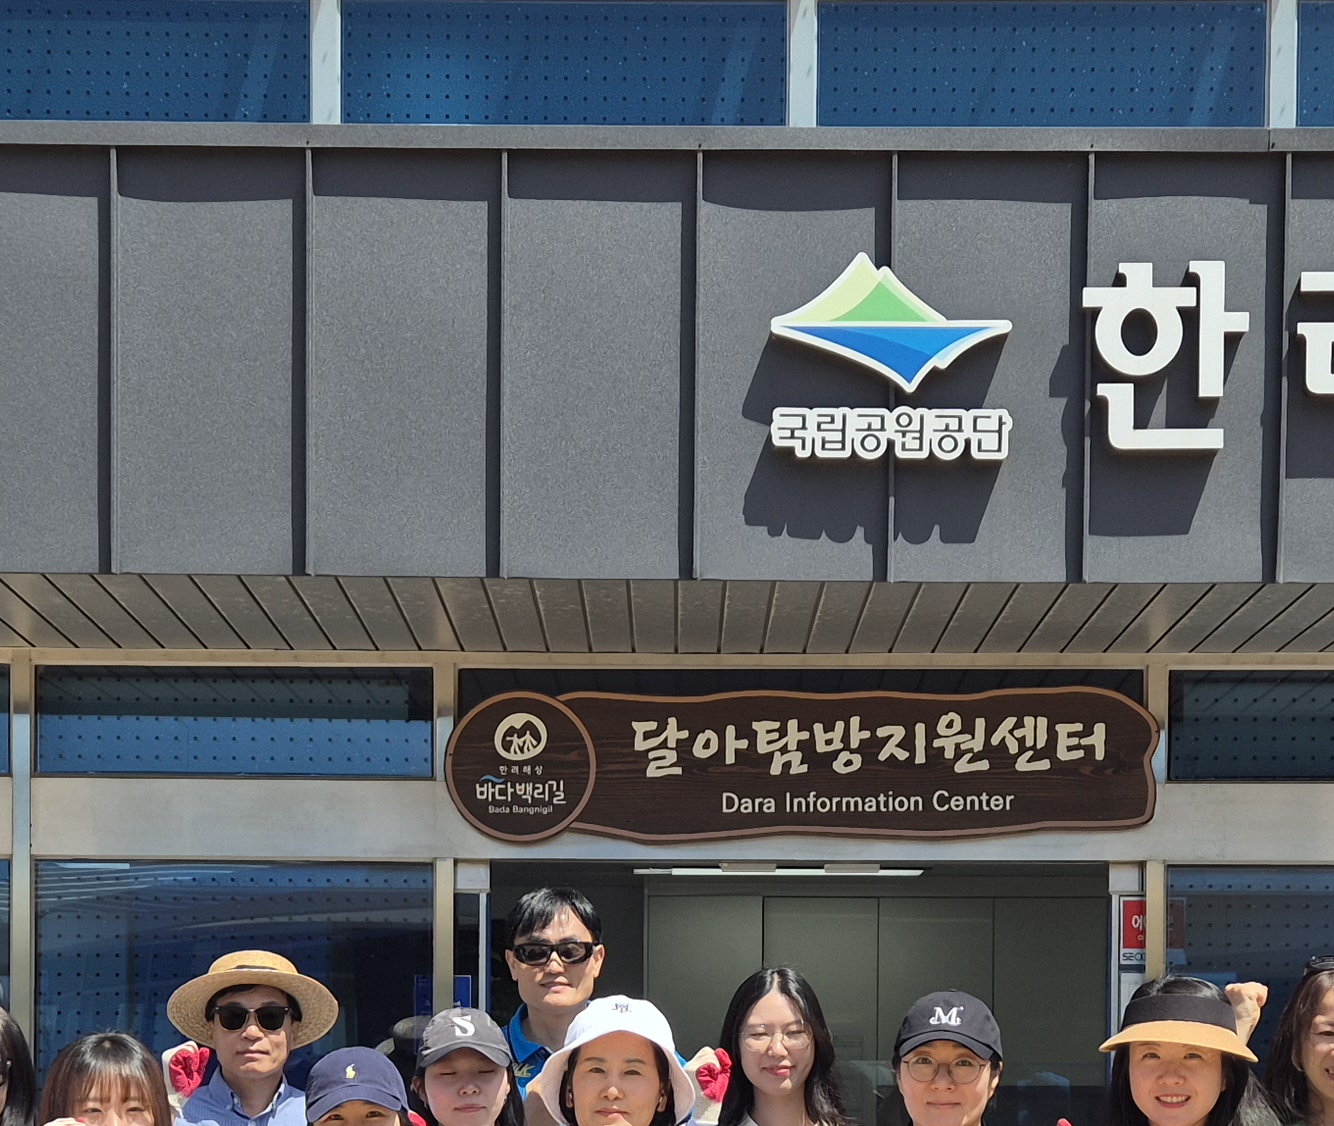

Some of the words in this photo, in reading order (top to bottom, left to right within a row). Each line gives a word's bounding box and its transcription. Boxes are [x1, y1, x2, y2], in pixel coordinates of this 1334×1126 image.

[775, 410, 1010, 456] 국립공원공단
[631, 711, 1107, 778] 달아탐방지원센터
[475, 779, 567, 804] 바다백리길
[722, 792, 776, 813] Dara
[785, 791, 923, 813] Information
[932, 790, 1015, 812] Center
[488, 805, 510, 813] Bada
[512, 805, 553, 815] Bangnigil
[451, 1015, 476, 1037] S
